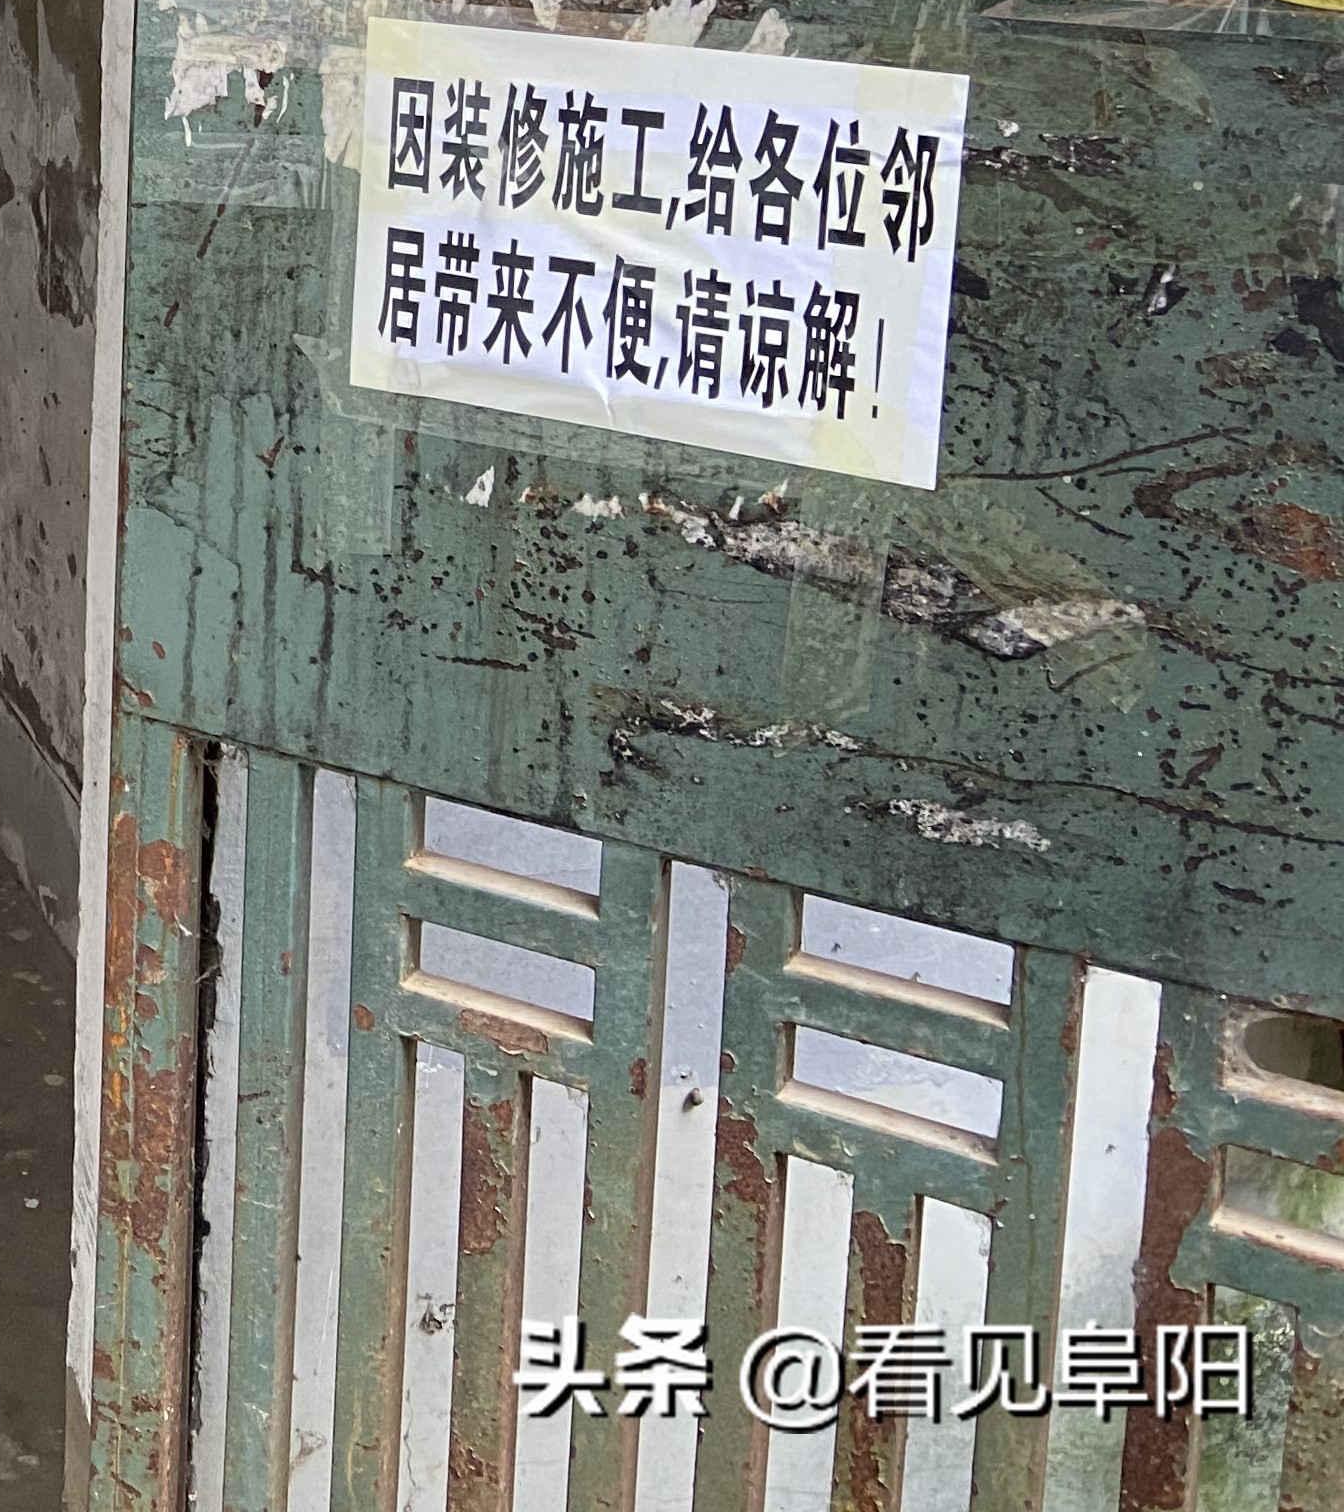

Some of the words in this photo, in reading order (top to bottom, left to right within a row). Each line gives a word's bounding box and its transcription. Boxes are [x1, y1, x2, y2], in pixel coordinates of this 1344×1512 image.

[387, 76, 941, 263] 因装修施工,给各位邻
[377, 226, 885, 420] 居带来不便,请谅解!
